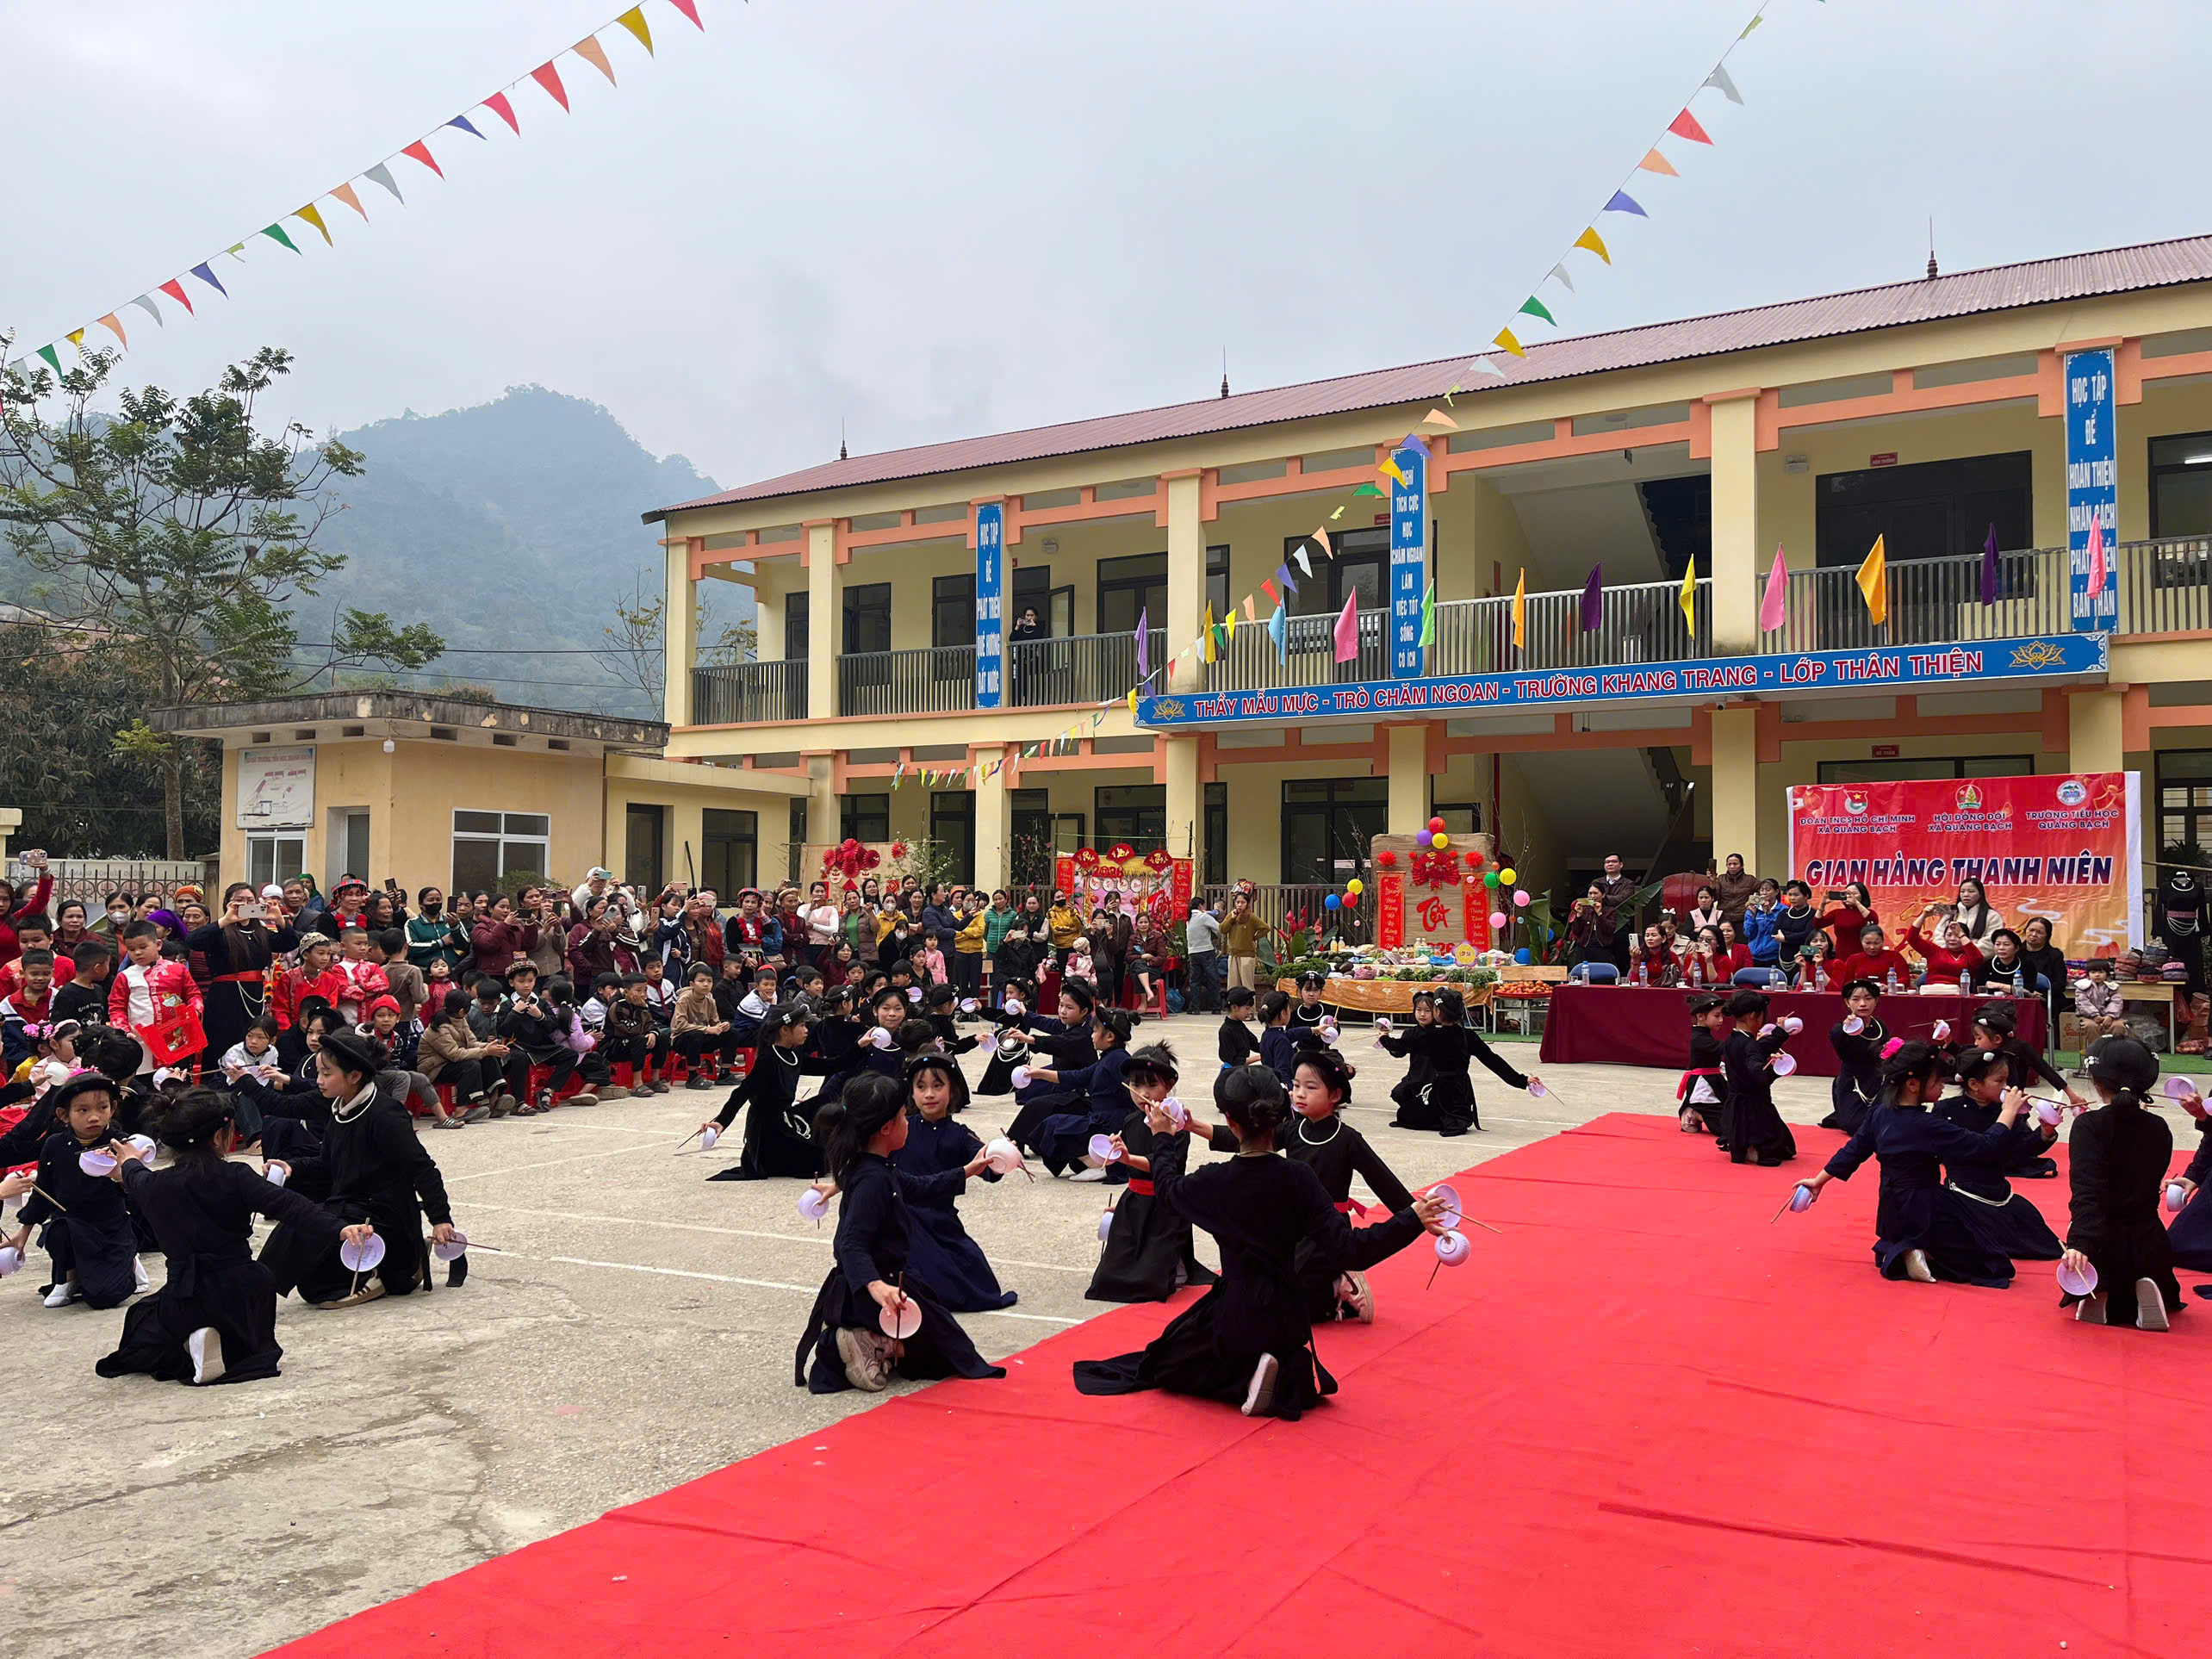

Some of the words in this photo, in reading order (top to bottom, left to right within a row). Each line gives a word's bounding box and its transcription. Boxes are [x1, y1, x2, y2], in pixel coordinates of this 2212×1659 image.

[2072, 376, 2088, 407] HỌC
[2091, 370, 2107, 406] TẬP
[2085, 408, 2097, 445] ĐỂ
[2069, 458, 2091, 489] HOÀN
[2091, 455, 2115, 491] THIỆN
[1396, 494, 1407, 513] TÍCH
[1408, 493, 1420, 514] CỰC
[2070, 500, 2091, 532] NHÂN
[980, 523, 989, 550] HỌC
[990, 518, 998, 549] TẬP
[1402, 520, 1413, 541] HỌC
[1392, 545, 1406, 565] CHĂM
[1407, 546, 1423, 563] NGOAN
[1401, 570, 1413, 590] LÀM
[1396, 596, 1407, 618] VIỆC
[1408, 594, 1419, 615] TỐT
[2072, 585, 2091, 618] BẢN
[1400, 621, 1414, 642] SỐNG
[1398, 649, 1406, 668] CÓ
[1407, 648, 1416, 668] ÍCH
[1194, 693, 1237, 717] THẦY
[1242, 689, 1277, 715] MẪU
[1282, 693, 1318, 716] MỰC
[1333, 687, 1370, 709] TRÒ
[1374, 684, 1426, 706] CHĂM
[1432, 682, 1499, 703] NGOAN
[1515, 674, 1597, 698] TRƯỜNG
[1602, 671, 1677, 693] KHANG
[1681, 666, 1757, 688] TRANG
[1780, 656, 1826, 683] LỚP
[1834, 652, 1900, 680] THÂN
[1909, 647, 1983, 678] THIỆN
[1800, 816, 1826, 825] ĐOÀN
[1855, 812, 1868, 823] HỒ
[1871, 813, 1888, 823] CHÍ
[1934, 812, 1952, 823] HỘI
[1954, 811, 1985, 821] ĐỒNG
[1987, 811, 2006, 821] ĐỘI
[2026, 810, 2068, 820] TRƯỜNG
[2072, 807, 2091, 817] TIỂU
[2095, 810, 2119, 819] HỌC
[1817, 824, 1830, 834] XÃ
[1833, 823, 1867, 833] QUẢNG
[1869, 825, 1897, 835] BẠCH
[1929, 823, 1943, 832] XÃ
[1945, 822, 1981, 831] QUẢNG
[1984, 823, 2012, 832] BẠCH
[2039, 819, 2078, 830] QUẢNG
[2079, 821, 2109, 830] BẠCH
[1805, 859, 1867, 888] GIAN
[1872, 850, 1946, 886] HÀNG
[1951, 857, 2041, 886] THANH
[2046, 848, 2113, 885] NIÊN
